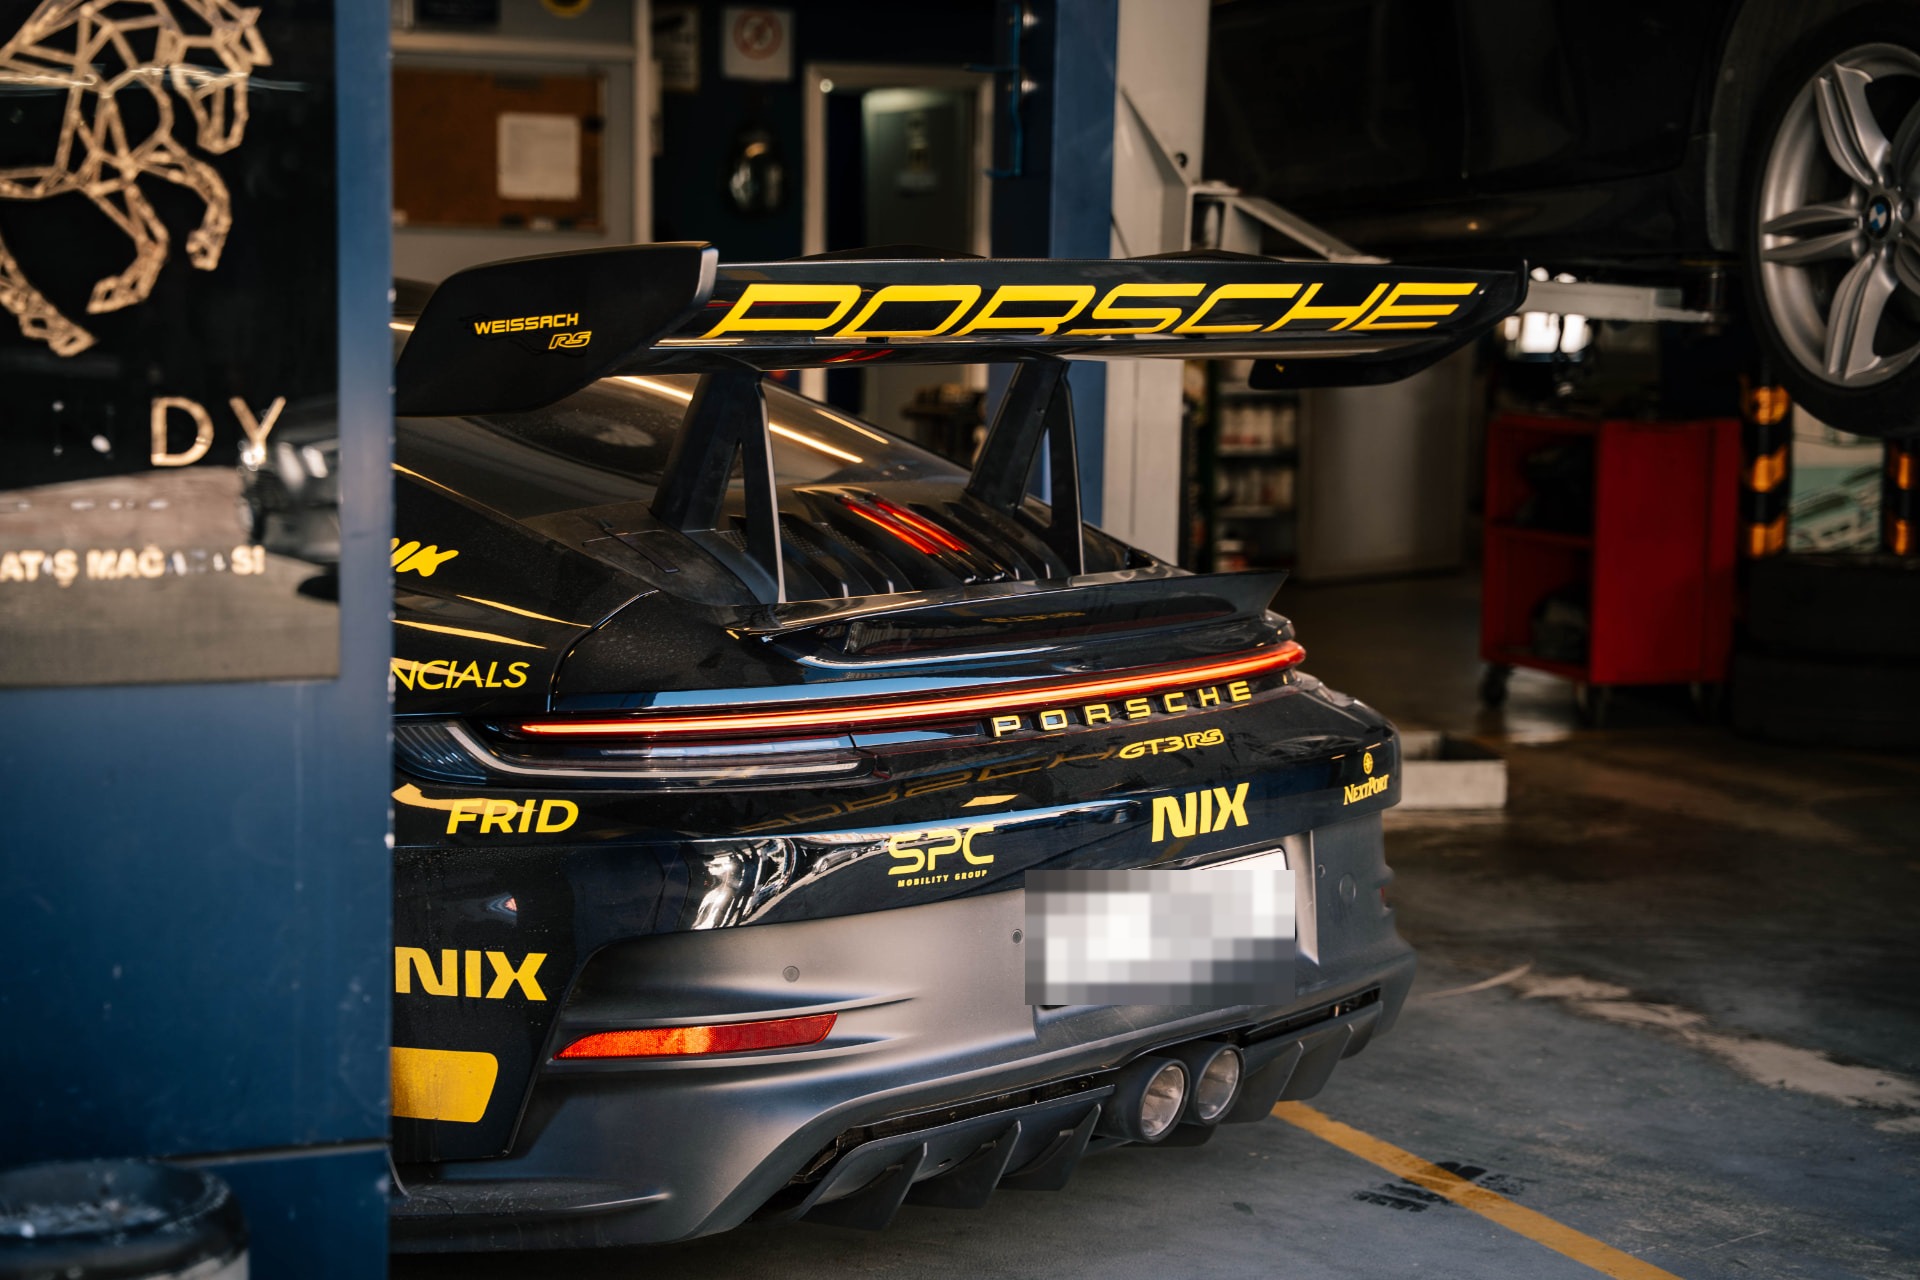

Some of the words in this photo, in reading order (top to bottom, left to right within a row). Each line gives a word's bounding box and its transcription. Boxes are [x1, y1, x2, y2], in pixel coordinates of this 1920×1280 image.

[474, 312, 579, 335] WEISSACH
[699, 282, 1478, 339] PORSCHE
[548, 330, 592, 350] RS
[991, 680, 1252, 738] PORSCHE
[446, 799, 579, 835] FRID
[1151, 782, 1250, 843] NIX
[887, 823, 995, 876] SPC
[897, 874, 949, 888] MOBILITY
[954, 869, 988, 881] GROUP
[394, 945, 548, 1001] NIX
